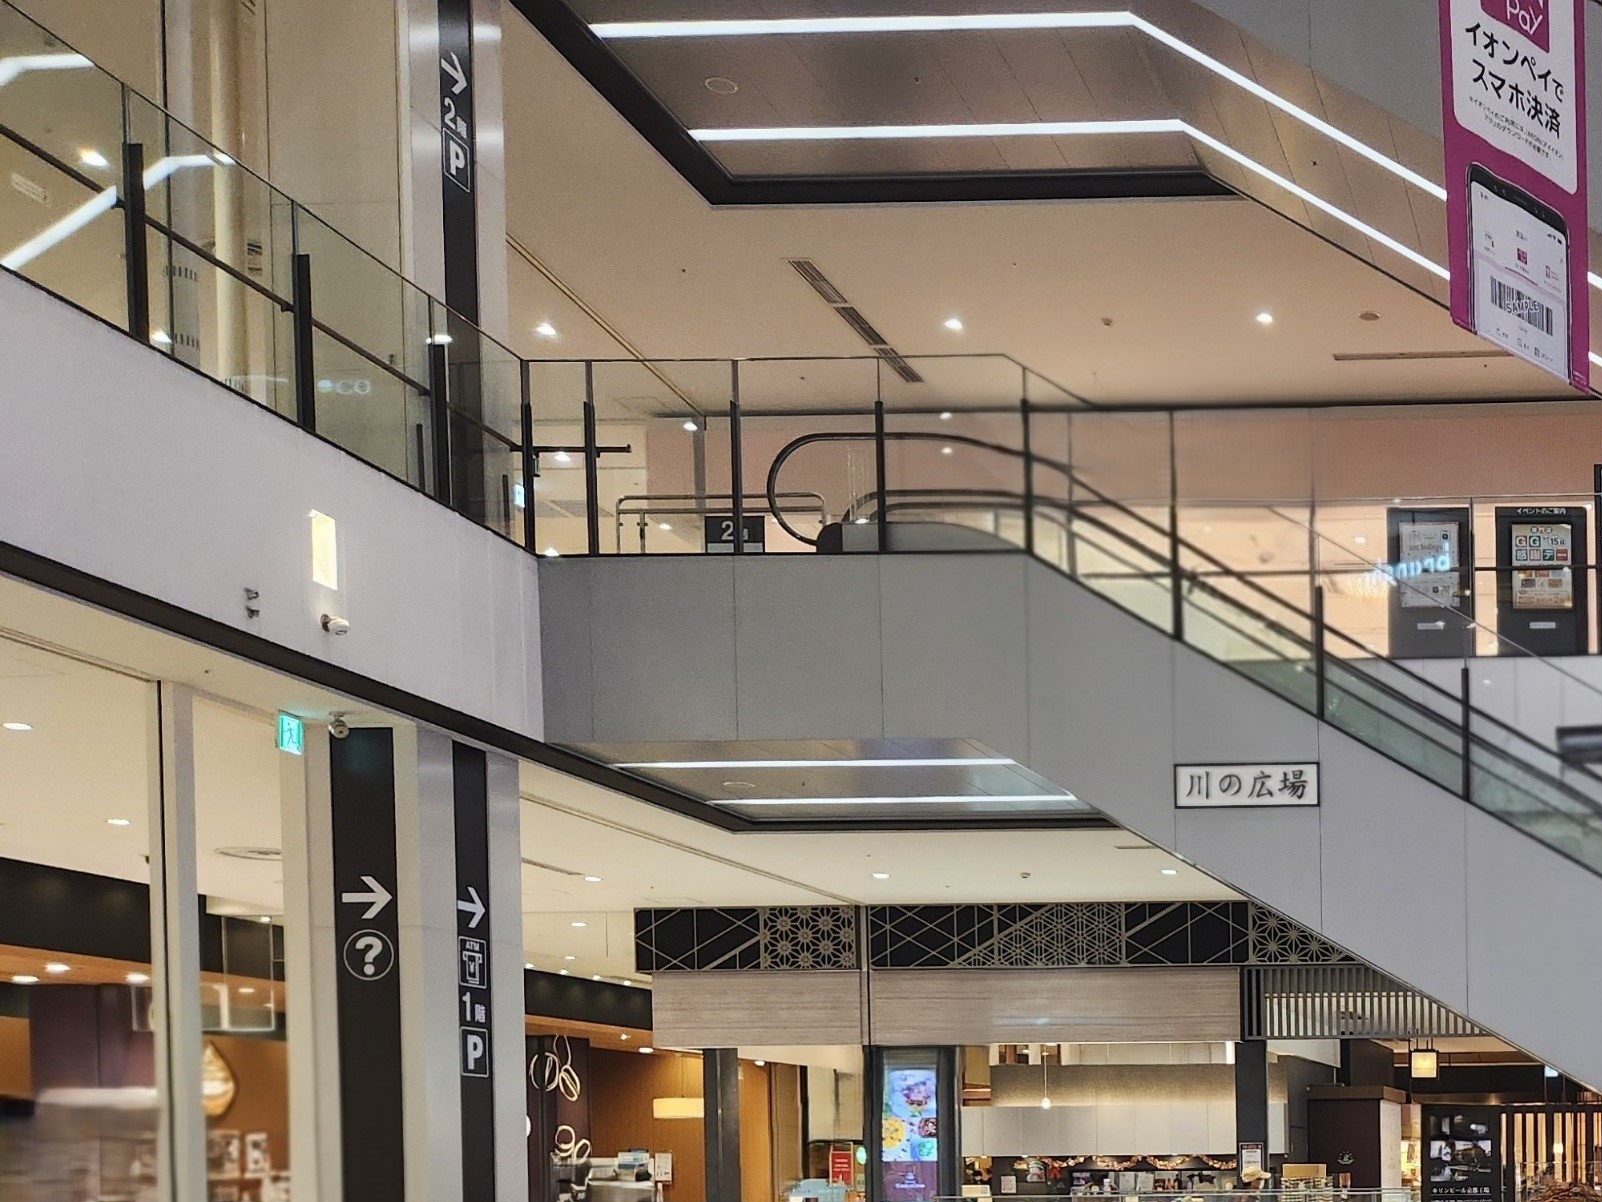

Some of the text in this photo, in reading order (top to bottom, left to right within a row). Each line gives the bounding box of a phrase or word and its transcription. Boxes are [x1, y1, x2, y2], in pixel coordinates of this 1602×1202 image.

[1465, 22, 1564, 103] イオンペイで
[1472, 58, 1561, 139] スマホ決済
[1506, 300, 1539, 313] SAMPLE
[1186, 770, 1307, 800] 川の広場
[465, 941, 480, 951] ATM
[462, 991, 486, 1023] 1階
